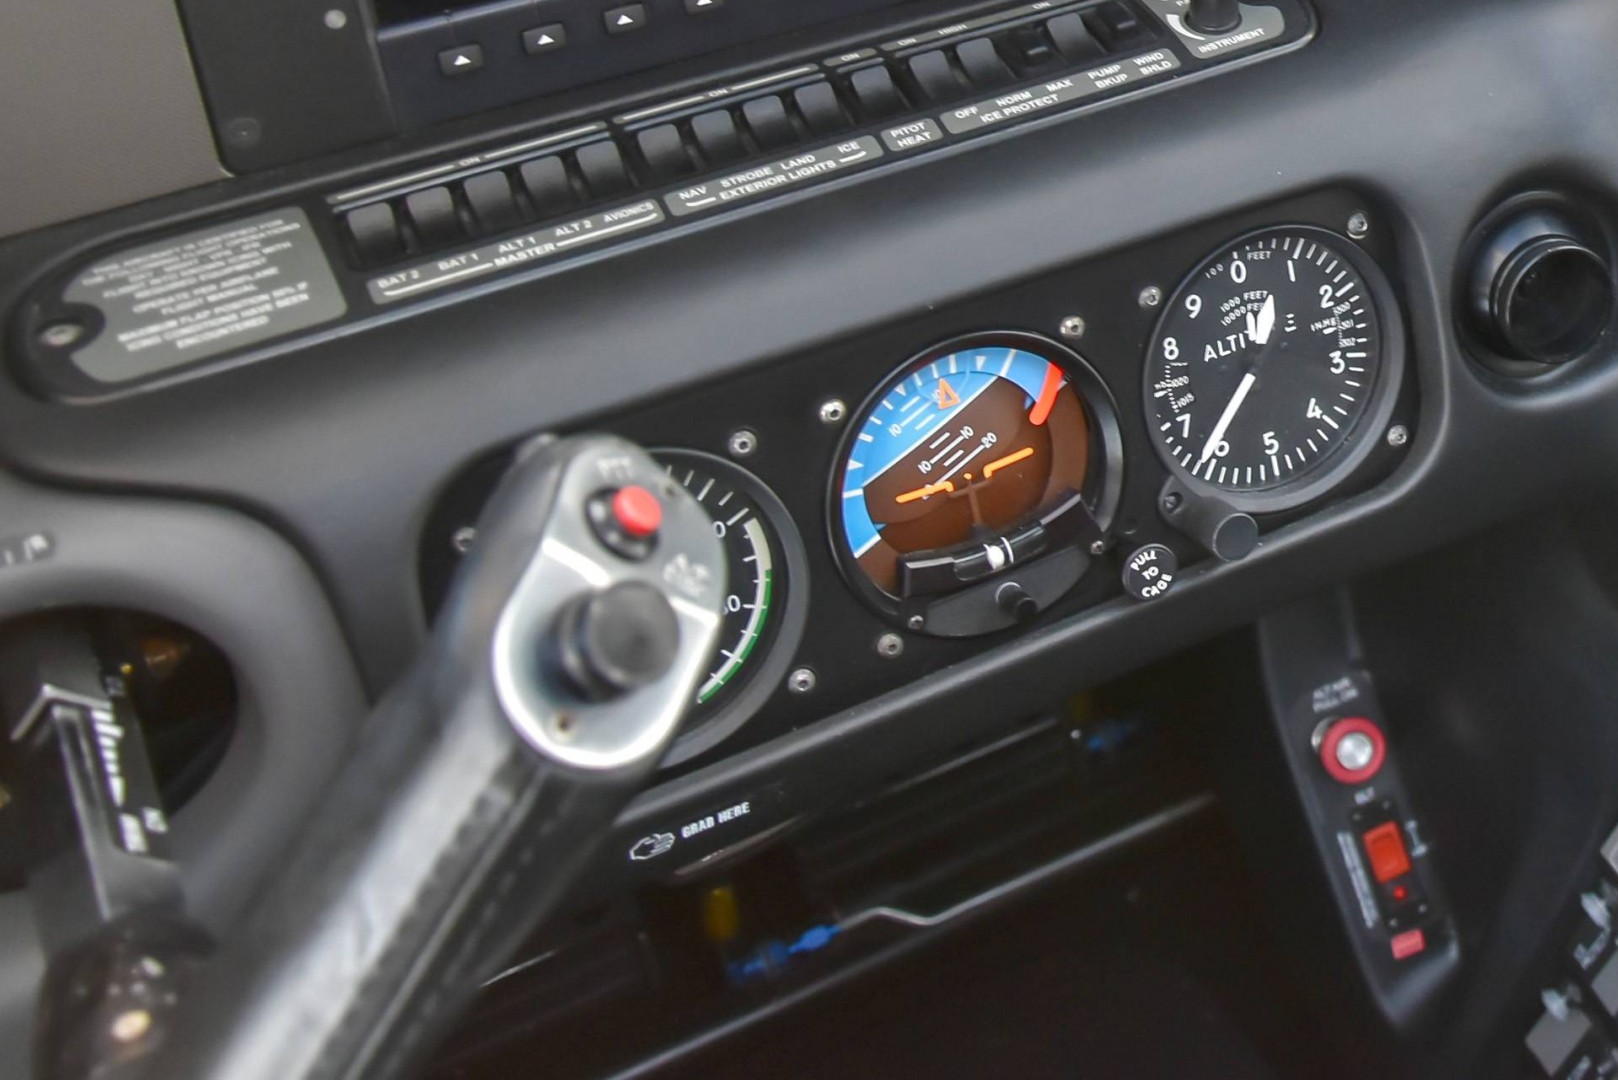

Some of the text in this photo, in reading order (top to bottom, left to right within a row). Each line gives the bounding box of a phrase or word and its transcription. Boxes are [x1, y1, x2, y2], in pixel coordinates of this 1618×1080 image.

[1198, 27, 1266, 54] INSTRUMENT
[1134, 52, 1164, 67] WIND
[1140, 60, 1172, 76] SHLD
[1088, 64, 1121, 80] PUMP
[1095, 72, 1128, 89] BKUP
[1046, 78, 1073, 93] MAX
[996, 90, 1032, 108] NORM
[954, 106, 979, 120] OFF
[980, 94, 1060, 124] ICE PROTECT
[890, 122, 926, 138] PITOT
[837, 141, 861, 154] ICE
[896, 131, 932, 148] HEAT
[780, 154, 816, 170] LAND
[719, 160, 837, 200] EXTERIOR LIGHTS
[720, 166, 774, 188] STROBE
[679, 186, 708, 200] NAV
[603, 202, 654, 222] AVIONICS
[554, 222, 582, 238] ALT
[498, 238, 527, 254] ALT
[494, 243, 556, 267] MASTER
[1247, 250, 1272, 260] FEET
[437, 256, 470, 272] BAT
[1204, 264, 1224, 279] 100
[1230, 260, 1247, 284] 0
[376, 273, 410, 288] BAT
[1220, 290, 1268, 313] 1000 FEET
[1318, 284, 1335, 308] 2
[1184, 294, 1202, 318] 9
[1220, 306, 1246, 326] 10000
[1162, 336, 1180, 360] 8
[1328, 350, 1346, 374] 3
[1306, 398, 1323, 420] 4
[960, 425, 974, 438] 10
[1176, 413, 1192, 438] 7
[980, 432, 998, 449] 20
[1262, 431, 1280, 455] 5
[918, 460, 932, 474] 10
[1130, 550, 1158, 571] PULL
[1141, 566, 1159, 580] TO
[1141, 574, 1173, 598] CAGE
[682, 801, 751, 839] GRAB HERE
